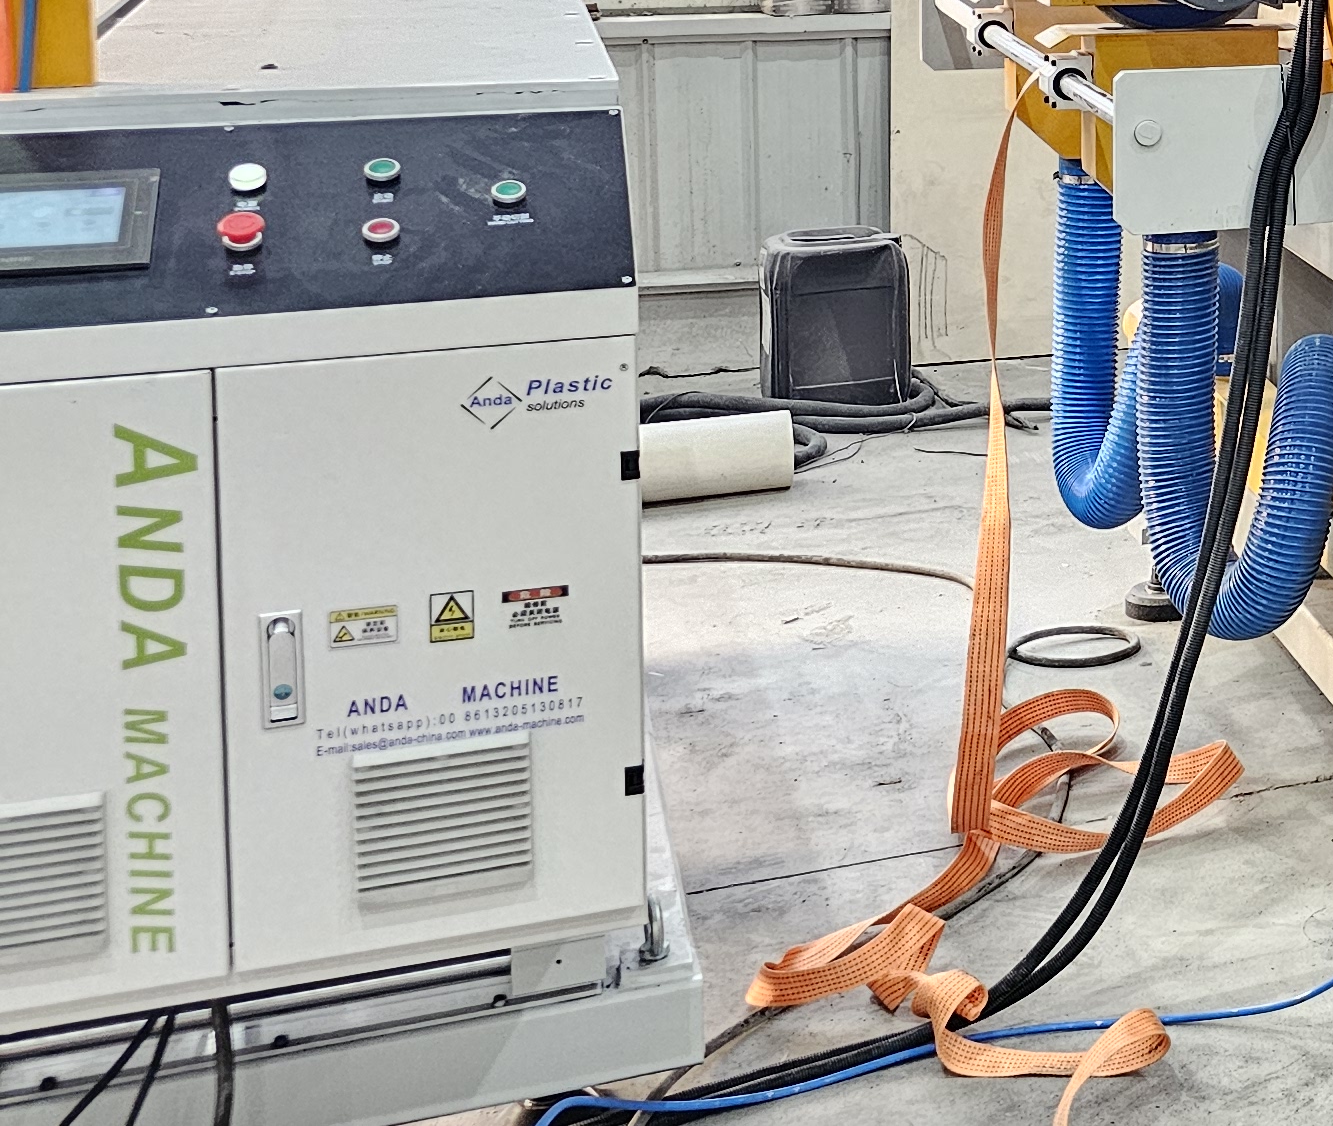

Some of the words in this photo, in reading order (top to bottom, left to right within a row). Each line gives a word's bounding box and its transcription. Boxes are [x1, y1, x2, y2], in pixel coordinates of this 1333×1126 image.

[526, 374, 613, 397] Plastic
[469, 393, 513, 408] Anda
[526, 398, 586, 412] solutions
[113, 422, 199, 671] ANDA
[346, 693, 409, 718] ANDA
[462, 675, 559, 704] MACHINE
[464, 696, 584, 722] 8613205130817
[122, 708, 177, 954] MACHINE
